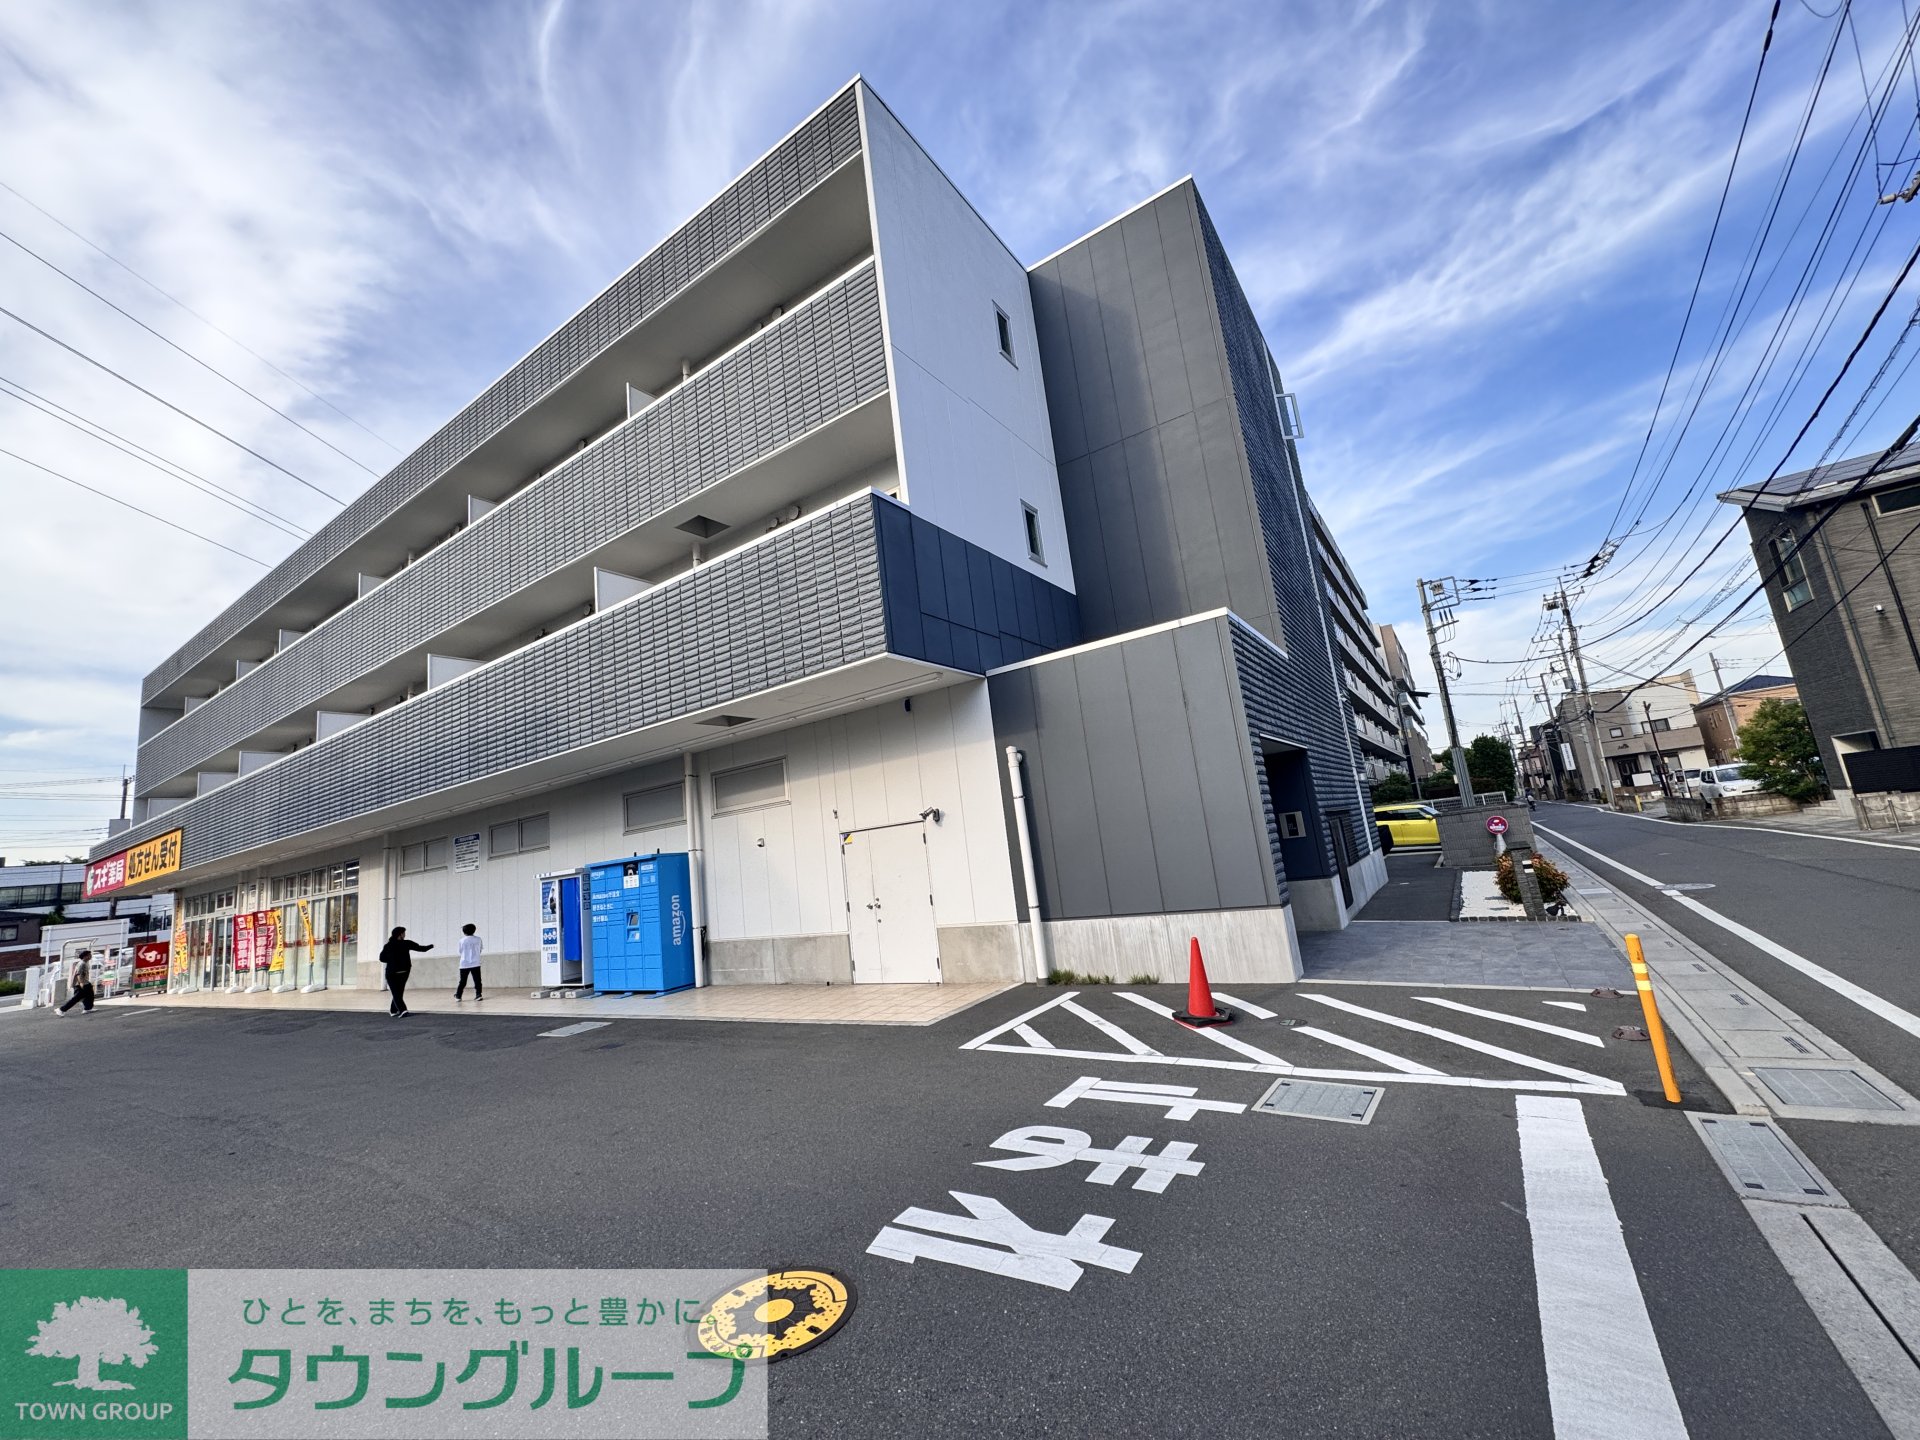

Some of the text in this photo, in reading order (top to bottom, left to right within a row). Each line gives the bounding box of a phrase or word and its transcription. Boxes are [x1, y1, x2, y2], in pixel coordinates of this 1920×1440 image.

[93, 858, 125, 890] スギ薬局
[128, 834, 178, 880] 処方せん受付
[671, 894, 683, 946] amazon
[137, 945, 167, 964] くすり
